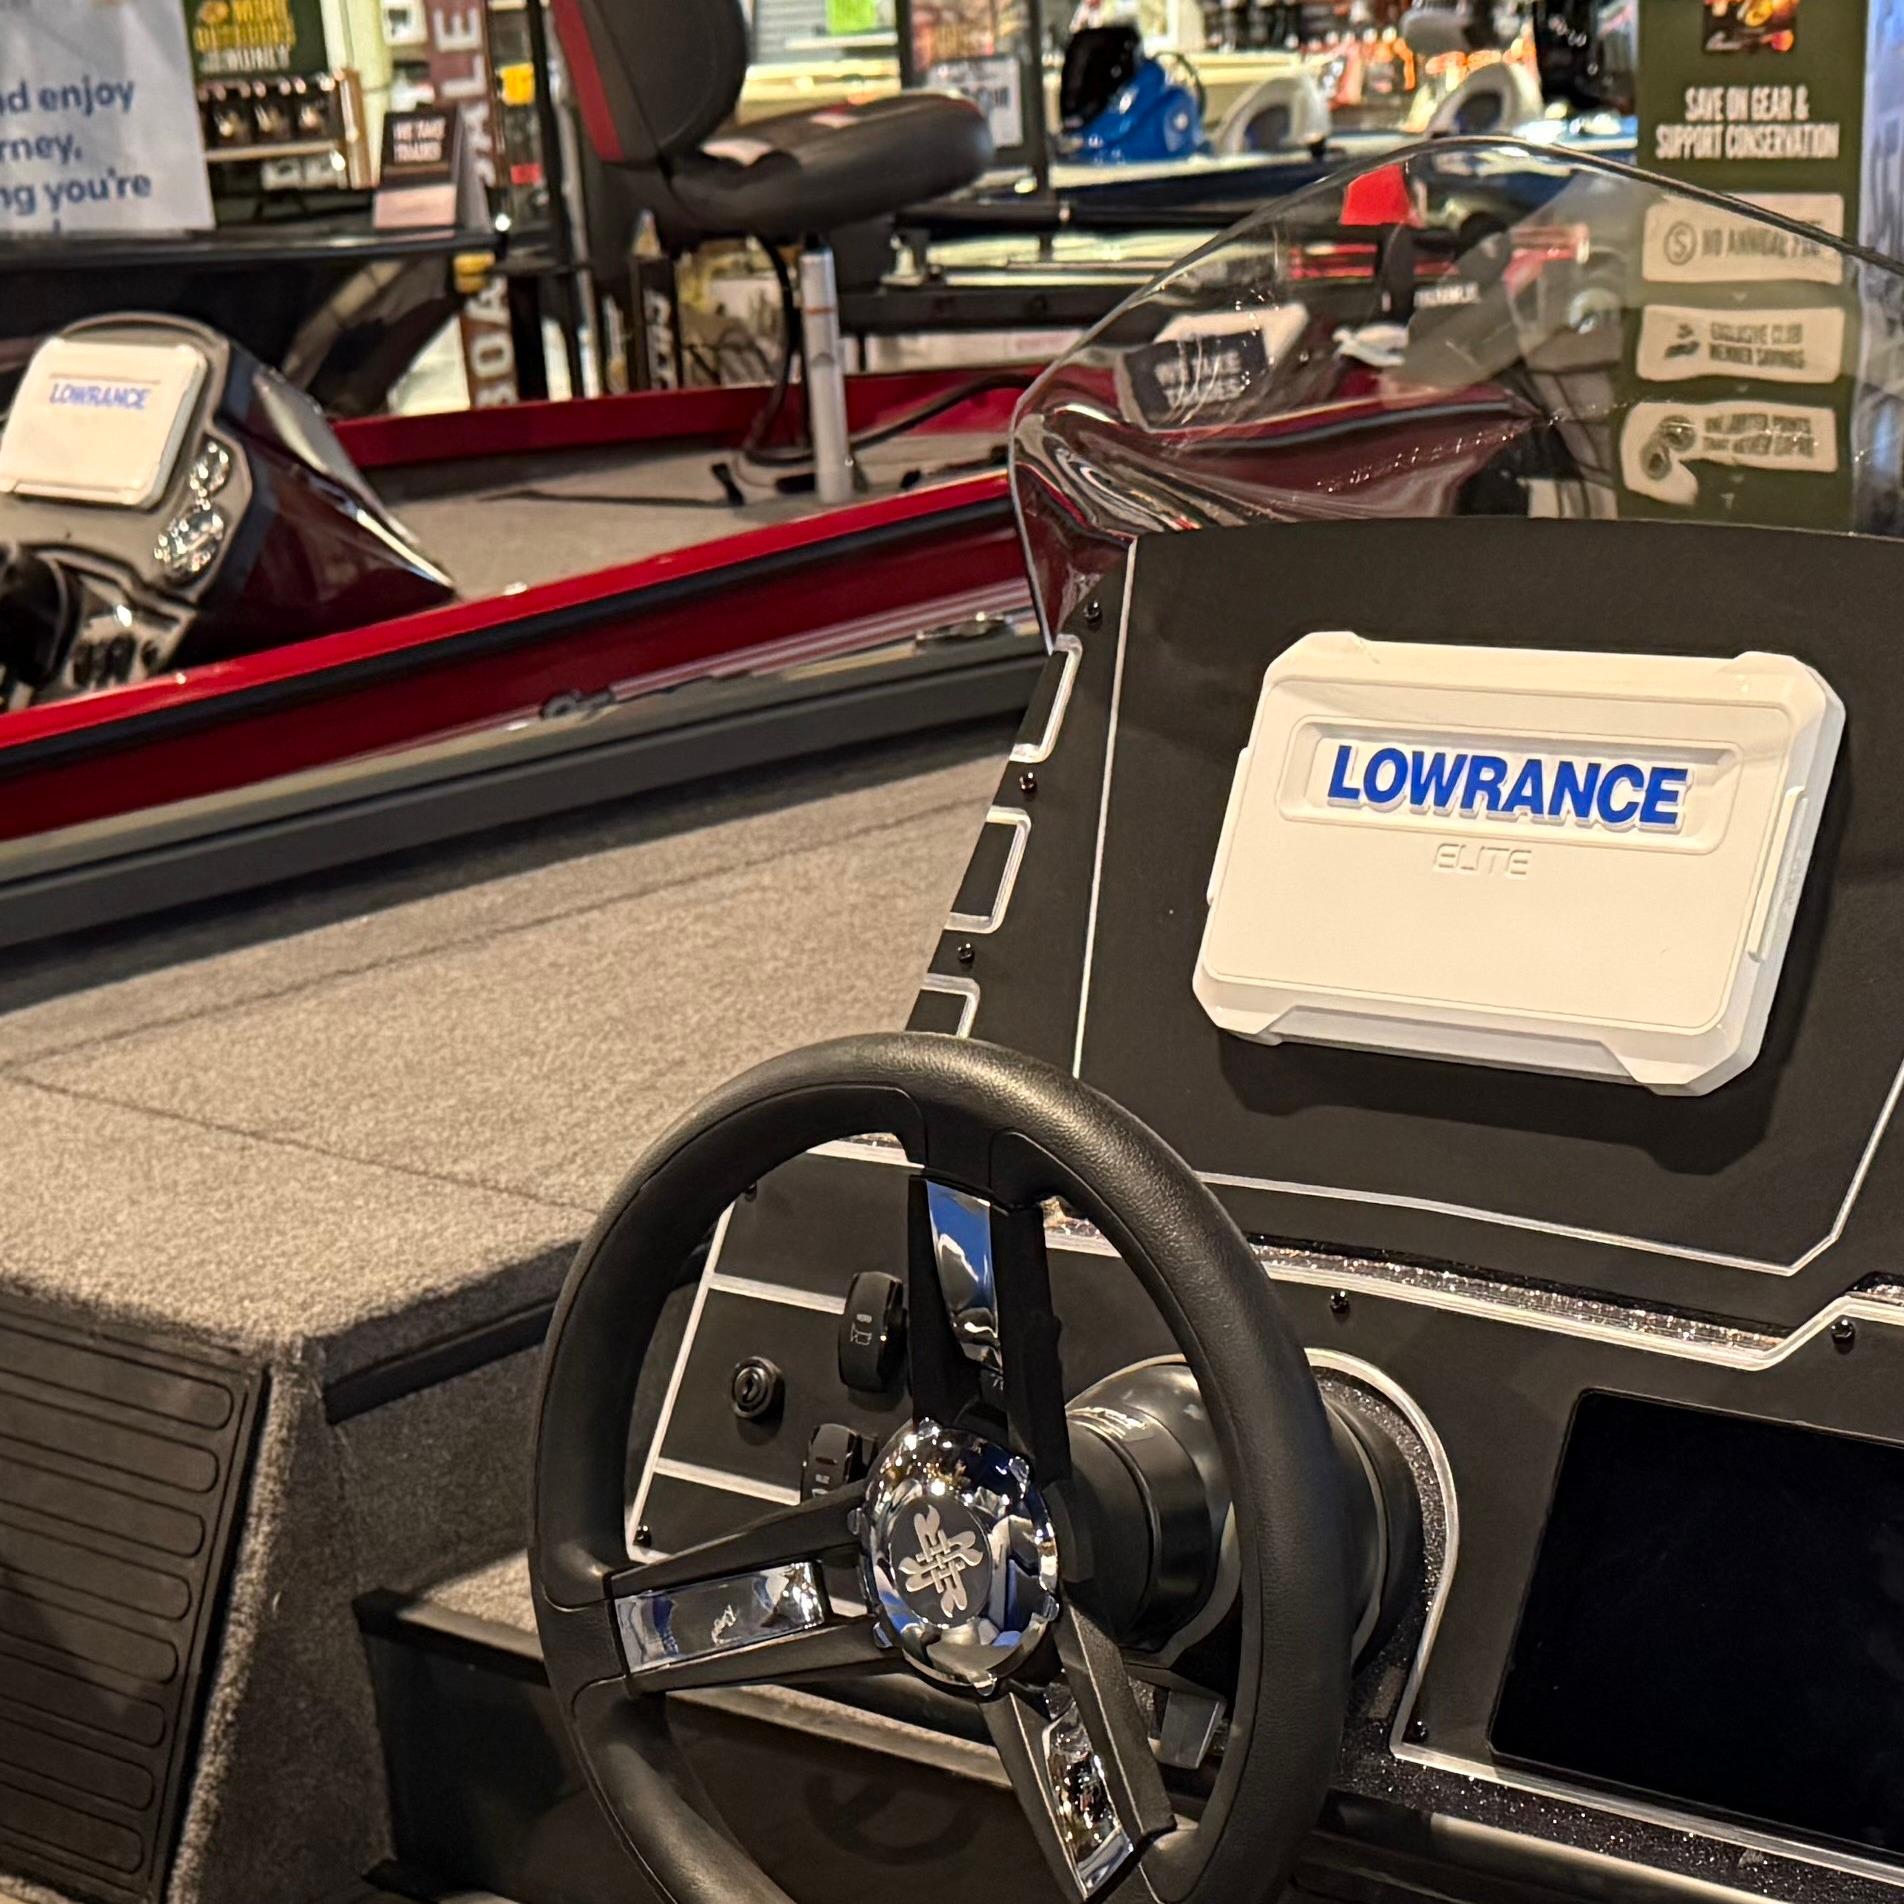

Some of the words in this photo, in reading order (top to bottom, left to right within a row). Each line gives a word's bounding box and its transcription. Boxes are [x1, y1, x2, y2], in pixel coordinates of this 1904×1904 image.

[39, 74, 134, 116] enjoy
[1685, 85, 1725, 121] SAVE
[1726, 86, 1749, 121] ON
[1751, 85, 1793, 121] GEAR
[1655, 124, 1724, 159] SUPPORT
[1725, 122, 1840, 159] CONSERVATION
[43, 168, 152, 213] you're
[49, 383, 151, 409] LOWRANCE
[1327, 744, 1689, 827] LOWRANCE
[1432, 842, 1533, 877] ELITE
